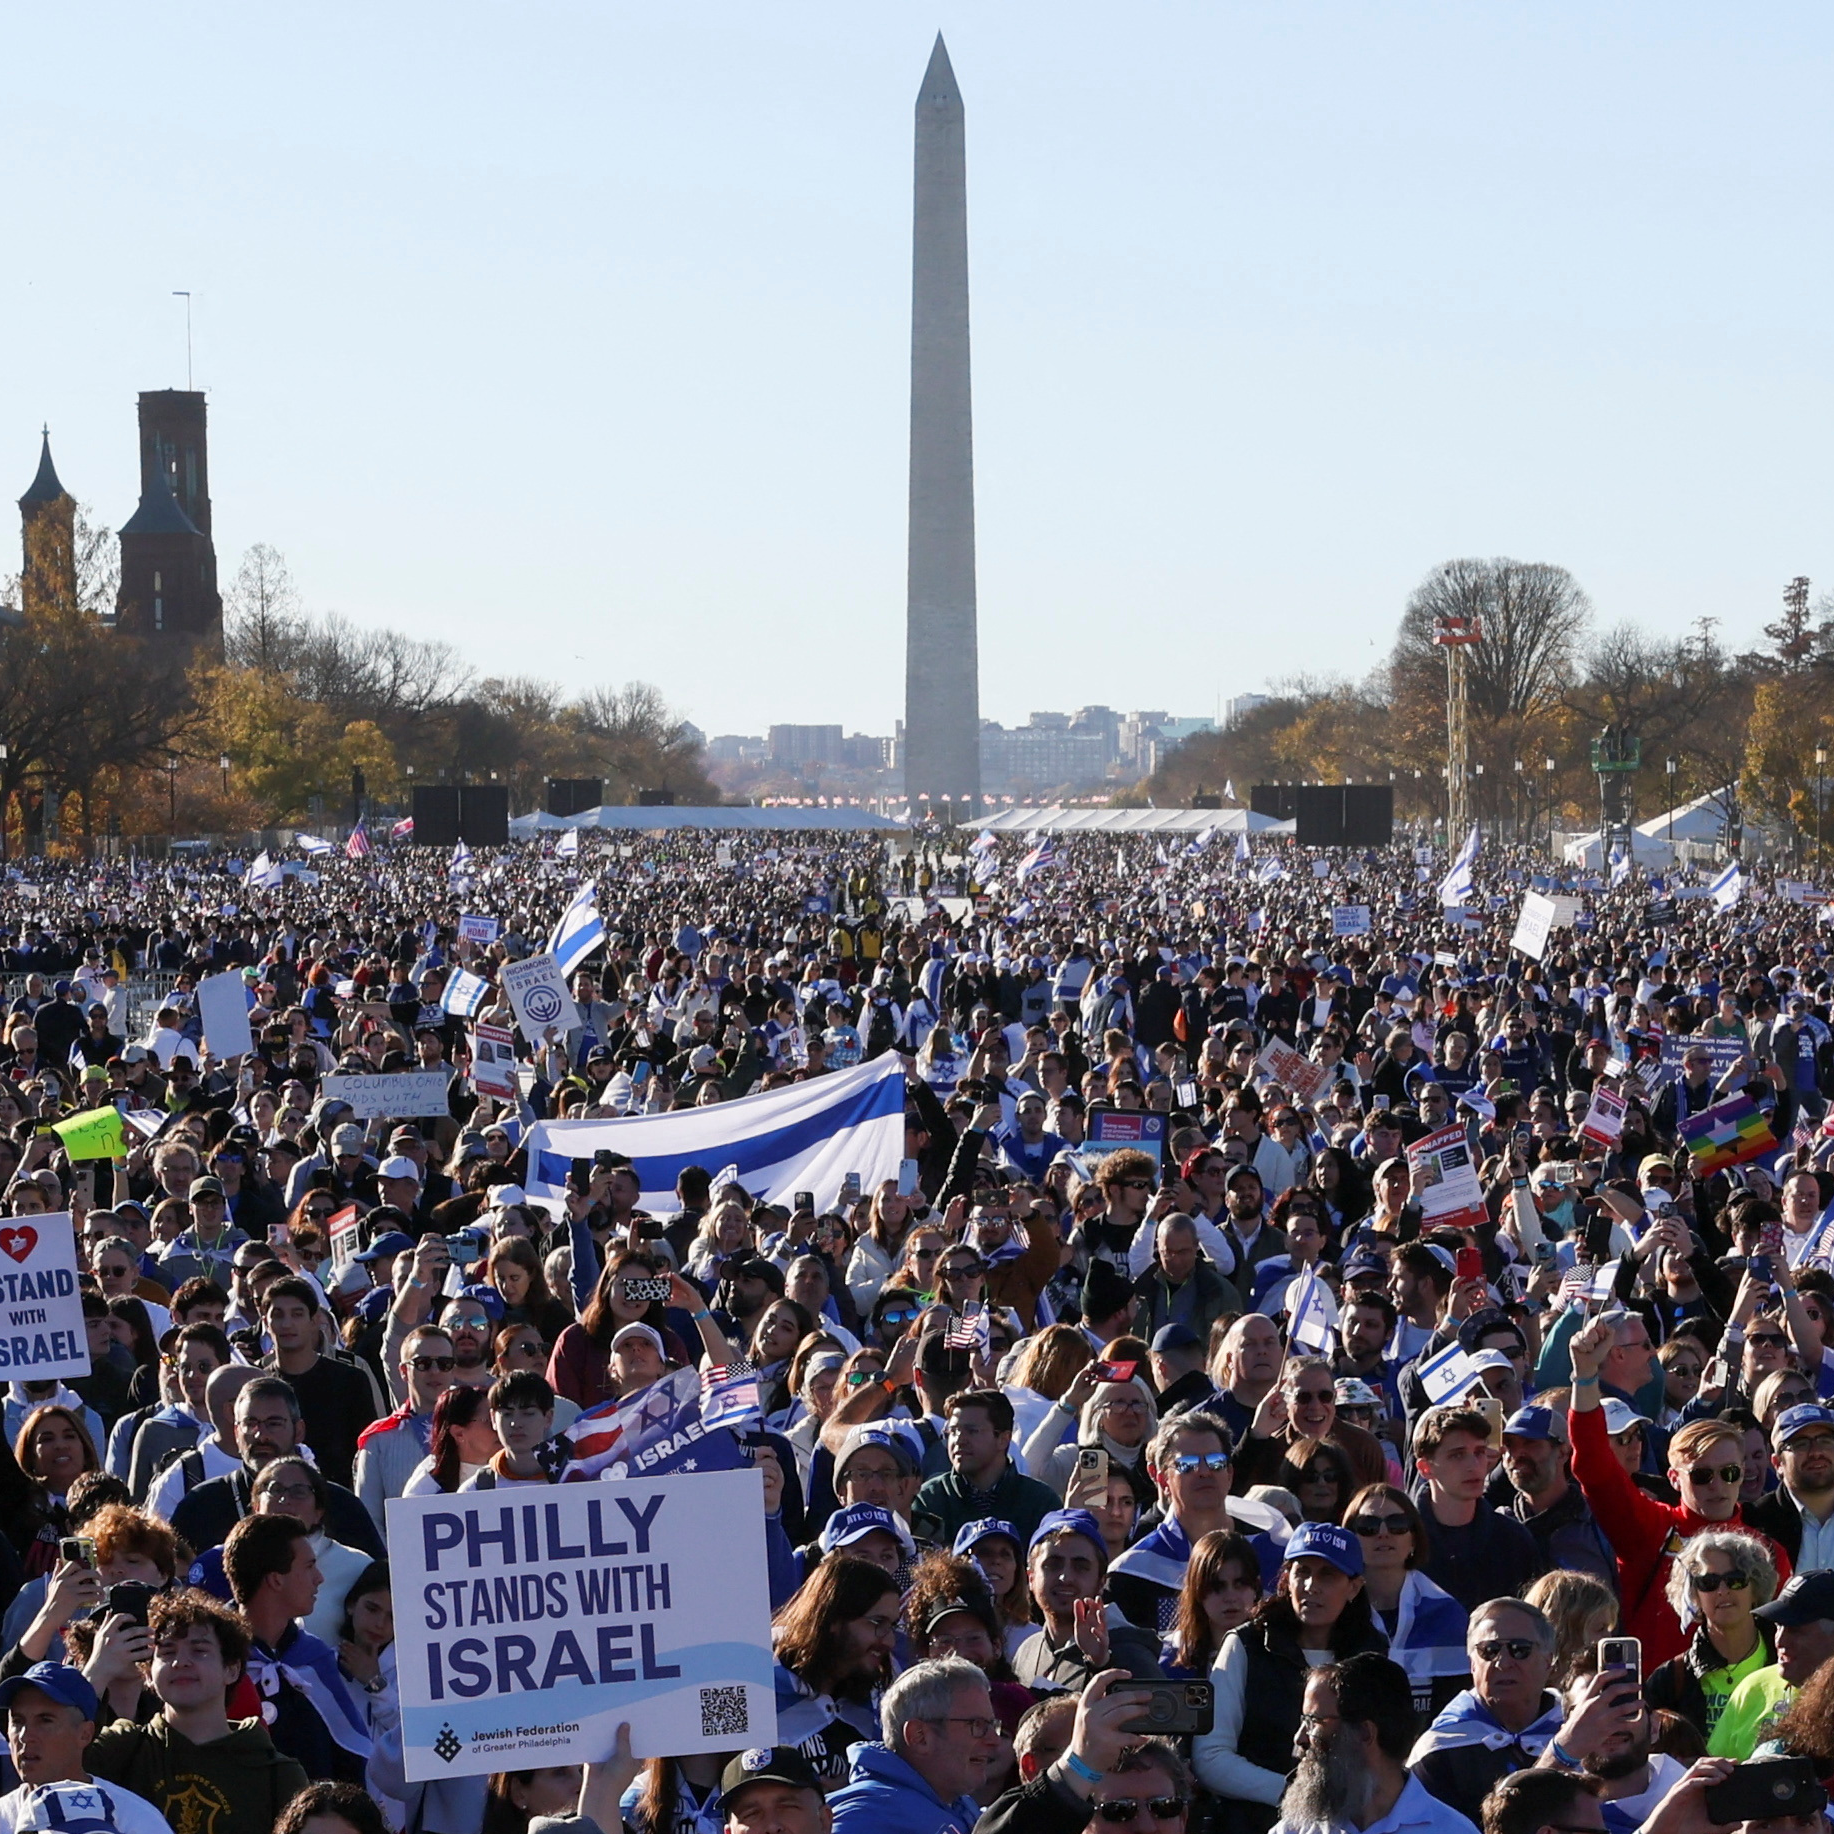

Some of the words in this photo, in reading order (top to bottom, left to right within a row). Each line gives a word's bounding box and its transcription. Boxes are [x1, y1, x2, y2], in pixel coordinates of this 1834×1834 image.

[467, 927, 489, 938] HOME
[505, 957, 551, 977] RICHMOND
[535, 965, 554, 976] WITH
[510, 972, 557, 991] ISRAEL
[476, 1028, 513, 1042] KIDNAPPED
[8, 1308, 47, 1326] WITH
[422, 1494, 666, 1572] PHILLY
[424, 1571, 568, 1629] STANDS
[576, 1563, 671, 1616] WITH
[427, 1623, 681, 1700] ISRAEL
[471, 1728, 513, 1743] Jewish
[515, 1721, 580, 1737] Federation
[471, 1744, 482, 1754] of
[483, 1741, 516, 1752] Greater
[517, 1736, 571, 1750] Philadelphia
